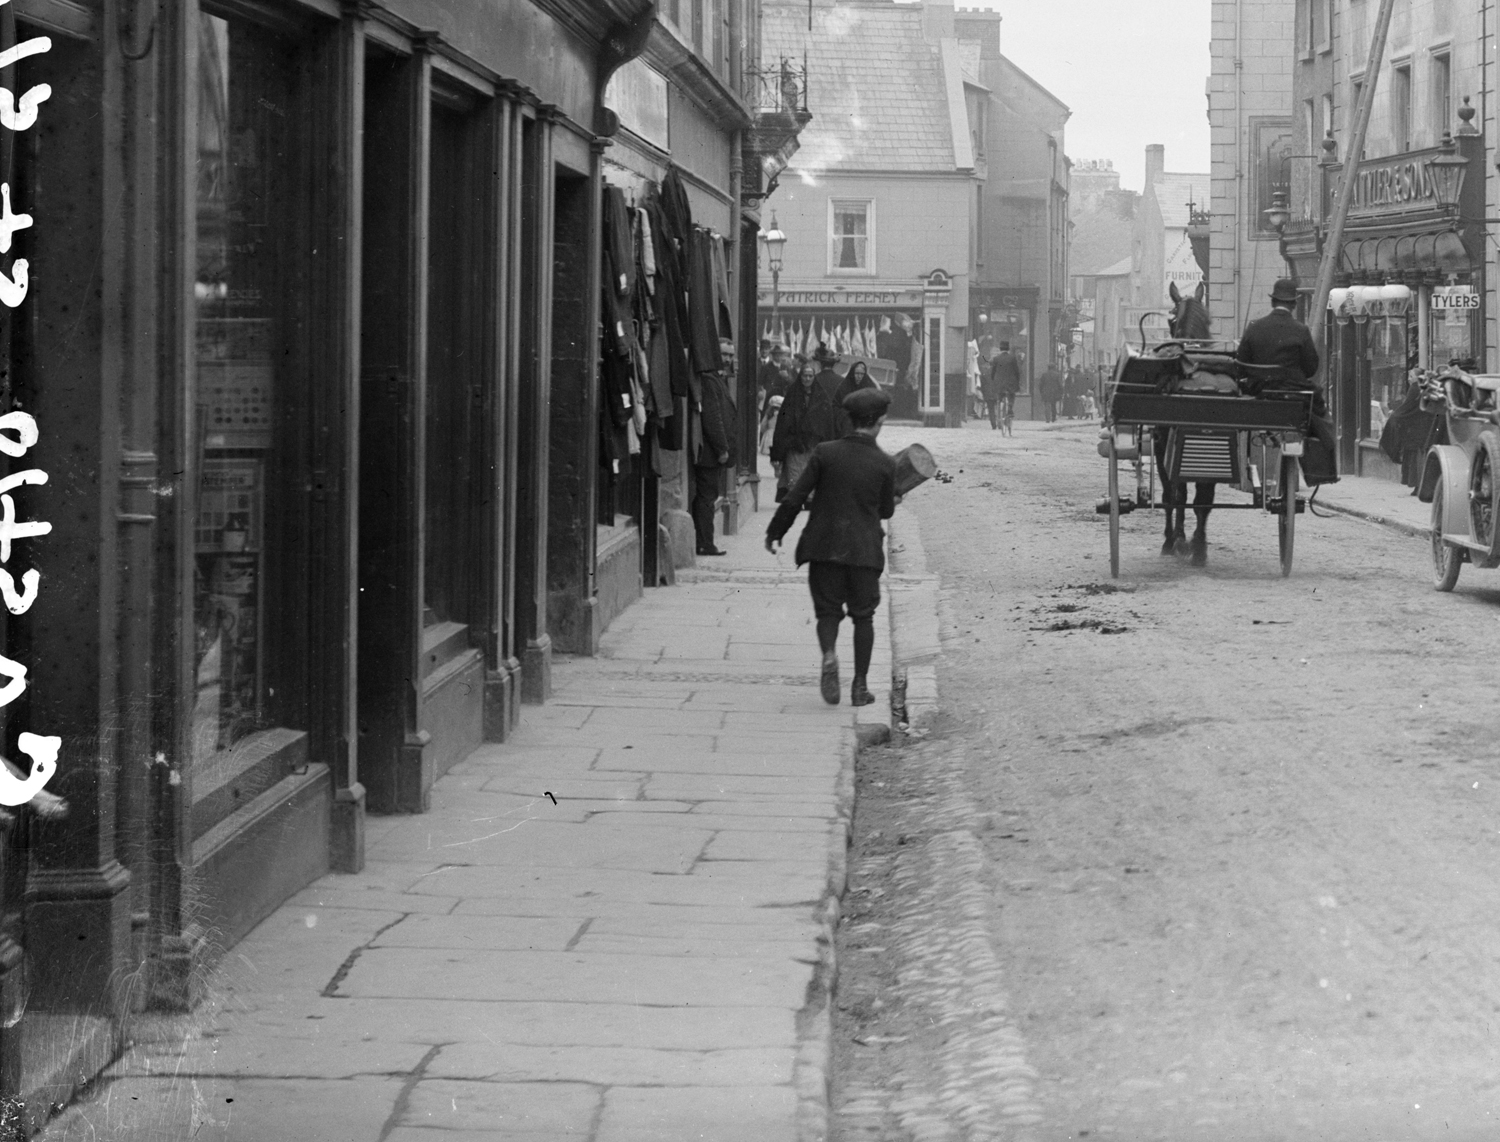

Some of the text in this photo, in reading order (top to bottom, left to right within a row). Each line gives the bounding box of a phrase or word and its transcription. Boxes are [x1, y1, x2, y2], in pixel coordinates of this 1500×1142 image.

[1359, 168, 1393, 208] TYLER
[1165, 271, 1202, 280] FURNIT
[778, 291, 900, 304] PATRICK FEENEY
[1433, 295, 1479, 308] TYLERS
